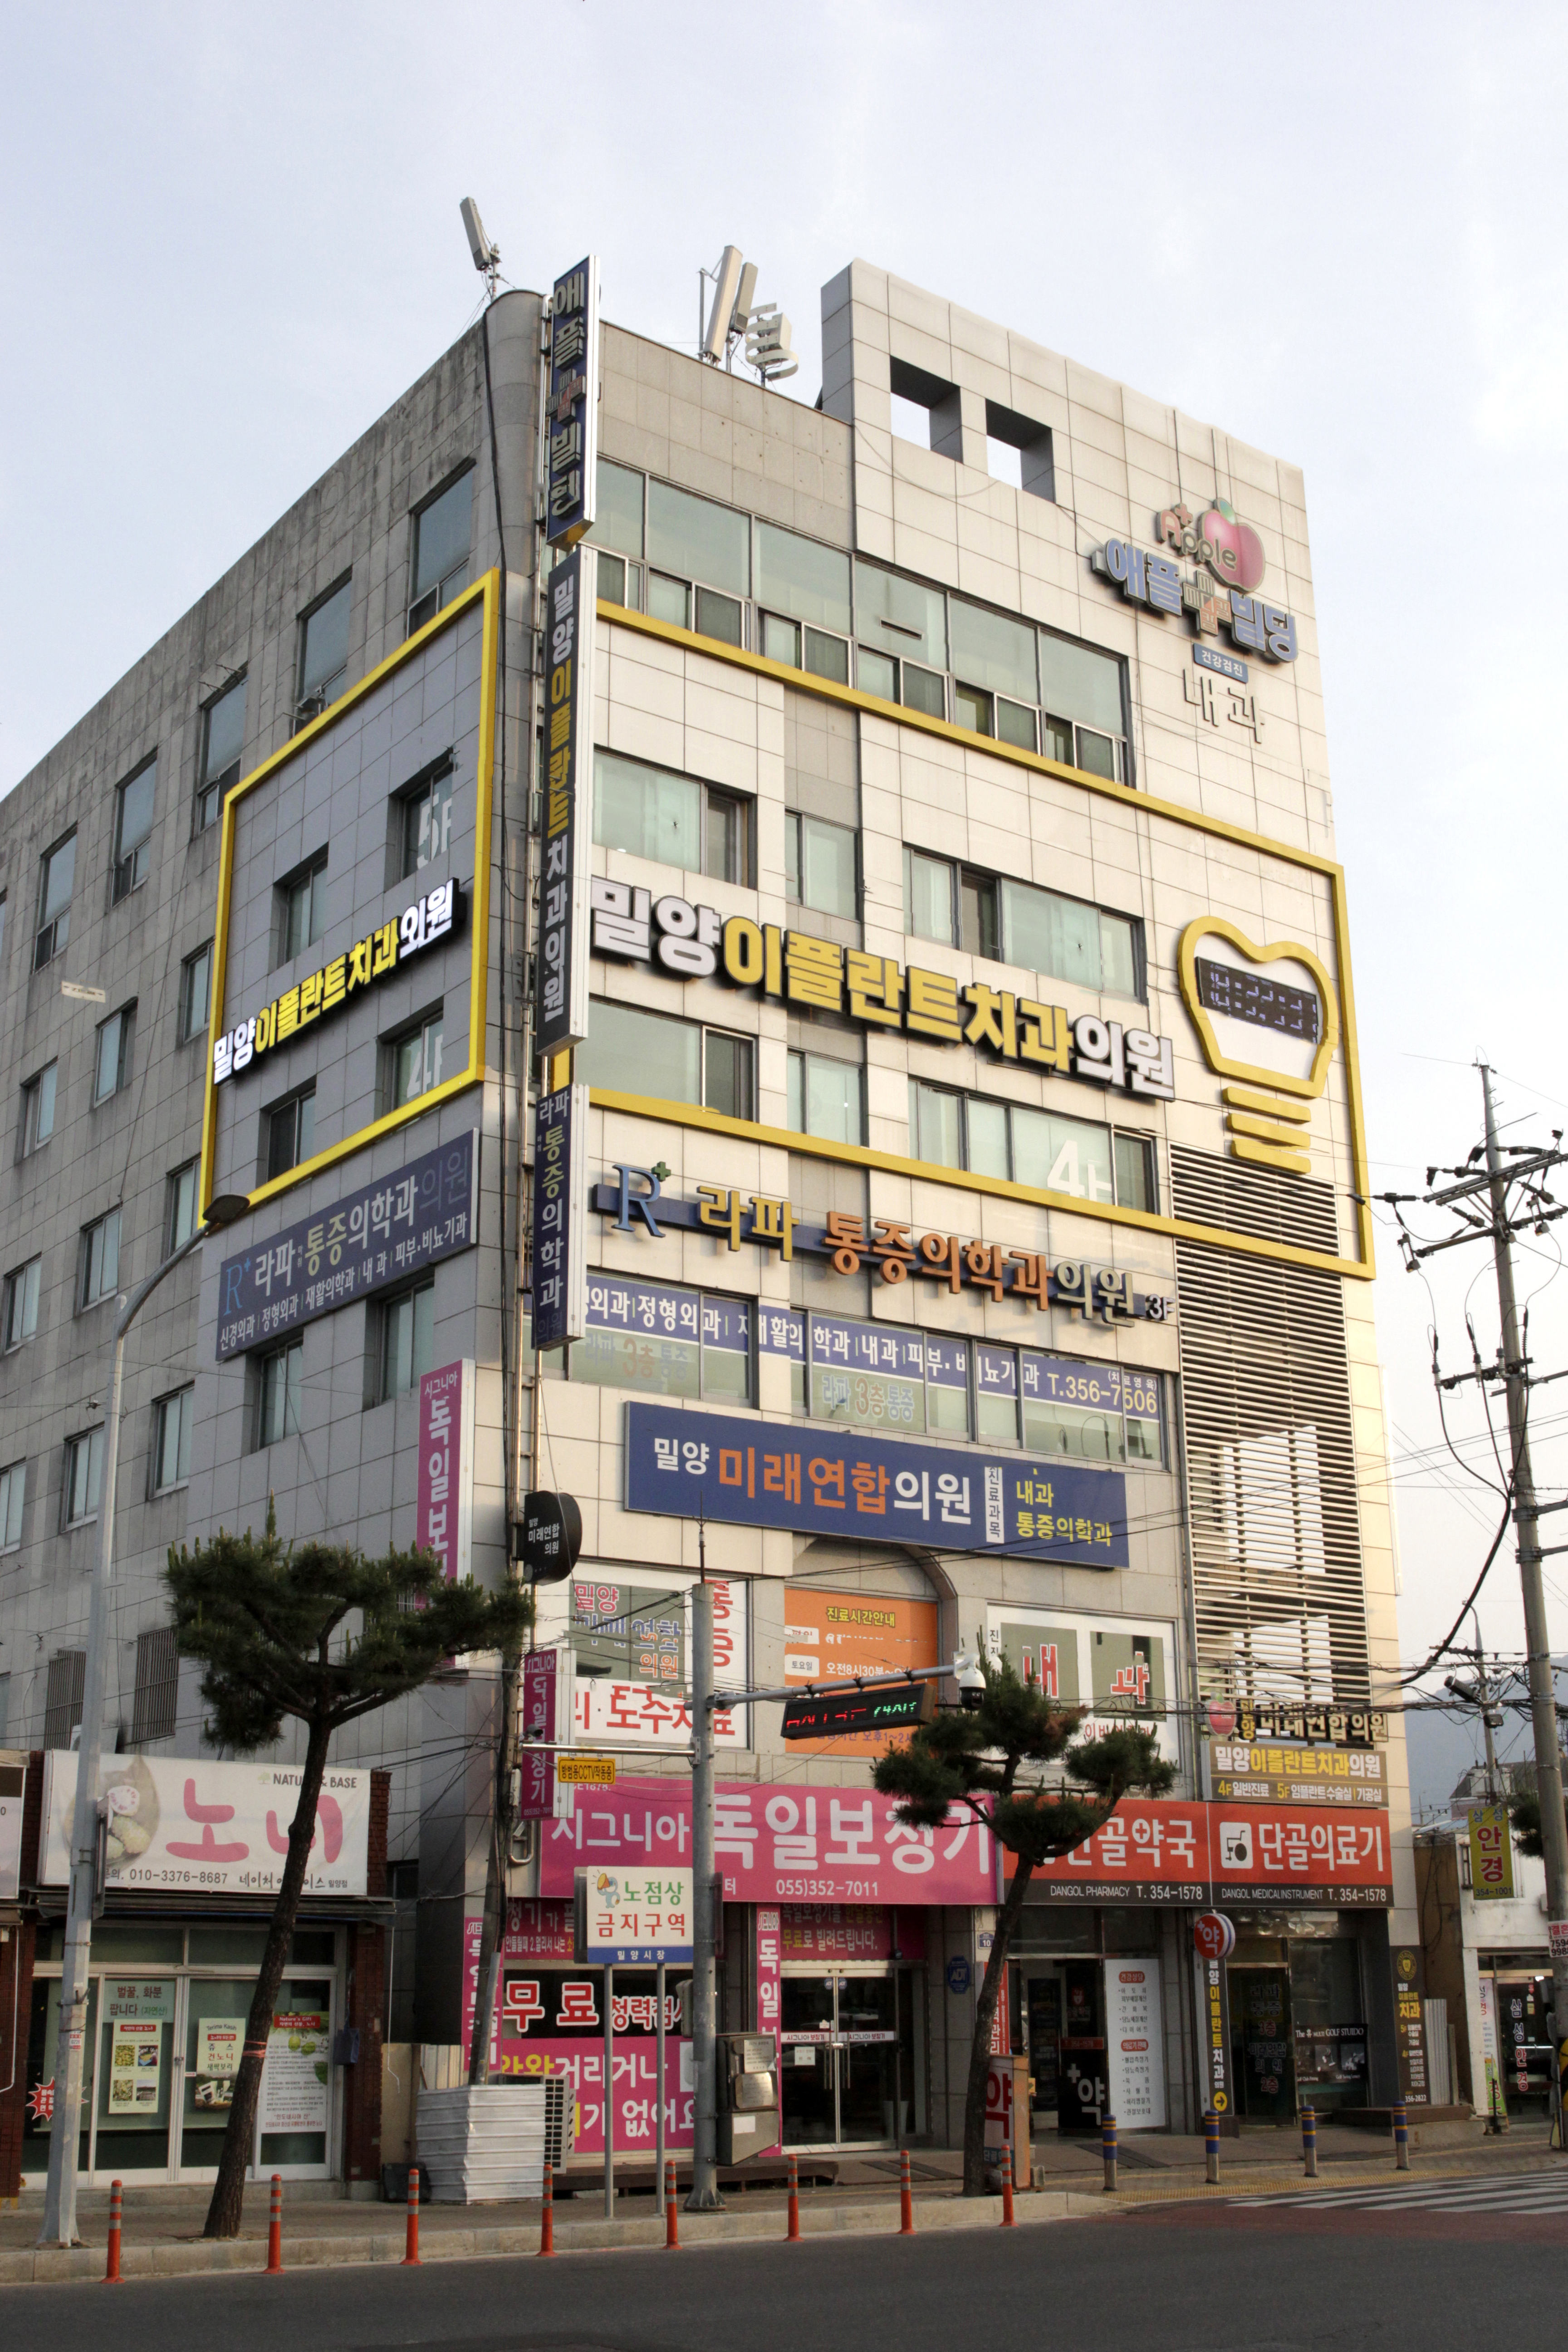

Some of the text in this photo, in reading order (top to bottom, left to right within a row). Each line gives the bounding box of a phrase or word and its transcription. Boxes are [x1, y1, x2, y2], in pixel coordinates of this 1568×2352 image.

[552, 271, 585, 373] 애플
[1105, 537, 1298, 662] 애플 빌딩
[1201, 650, 1243, 677] 건강검진
[1182, 669, 1266, 744] 내과
[540, 1091, 569, 1124] 라파
[697, 1186, 799, 1261] 라파
[1146, 1294, 1176, 1320] 3F
[255, 1240, 296, 1296] 라파
[220, 1314, 255, 1351] 신경외과
[261, 1294, 299, 1332] 정형외과
[305, 1267, 355, 1310] 재활의학과
[638, 1294, 721, 1340] 정형외과
[862, 1335, 898, 1367] 내과
[623, 1338, 655, 1378] 3층
[424, 1372, 458, 1397] 시그니아
[855, 1377, 885, 1418] 3층
[887, 1384, 915, 1422] 통증
[655, 1438, 971, 1525] 밀양 미래연합의원
[989, 1467, 1000, 1538] 진료과목
[1016, 1480, 1054, 1507] 내과
[528, 1523, 560, 1543] 미래연합
[1016, 1511, 1112, 1547] 통증의학과
[544, 1541, 559, 1555] 의원
[575, 1584, 619, 1613] 밀양
[826, 1606, 896, 1628] 진료시간안내
[640, 1654, 679, 1679] 의원
[791, 1661, 812, 1671] 토요일
[330, 1777, 358, 1788] BASE
[1218, 1780, 1232, 1796] 4F
[1232, 1781, 1269, 1797] 일반진료
[1277, 1783, 1290, 1798] 5F
[1357, 1788, 1382, 1802] 기공실
[1473, 1808, 1504, 1823] 삼성
[552, 1808, 690, 1852] 시그니아
[1259, 1823, 1383, 1872] 단골의료기
[1477, 1826, 1504, 1883] 안경
[130, 1869, 348, 1889] 010-3376-8687 네이처 밀양점
[776, 1878, 878, 1896] 055)352-7011
[624, 1881, 684, 1906] 노점상
[1050, 1885, 1084, 1896] DANGOL
[1086, 1886, 1130, 1897] PHARMACY
[1150, 1885, 1203, 1900] 354-1578
[1221, 1888, 1250, 1899] DANGOL
[1339, 1887, 1387, 1902] 354-1578
[1476, 1886, 1512, 1896] 354-1001
[596, 1913, 685, 1937] 금지구역
[554, 1936, 565, 1952] 나는
[783, 1930, 813, 1950] 무료로
[1202, 1926, 1220, 1955] 약
[1551, 1946, 1568, 1956] 998
[617, 1950, 665, 1961] 밀양시장
[1121, 1973, 1143, 1982] 건강상담
[143, 1986, 162, 1999] 화분
[1250, 1984, 1282, 1999] 라파
[109, 2003, 138, 2016] 팝니다
[503, 1980, 599, 2033] 무료
[1251, 2001, 1283, 2017] 통증
[1399, 2002, 1421, 2019] 치과
[1259, 2019, 1277, 2037] 3층
[1326, 2029, 1340, 2037] GOLF
[208, 2053, 233, 2061] 건노니
[1250, 2043, 1287, 2058] 미래연합
[207, 2063, 233, 2071] 새싹보리
[1255, 2059, 1283, 2074] 의원
[1261, 2076, 1279, 2094] 2층
[986, 2072, 1012, 2139] 약
[1078, 2077, 1105, 2126] 약
[1405, 2095, 1427, 2103] 356-2822
